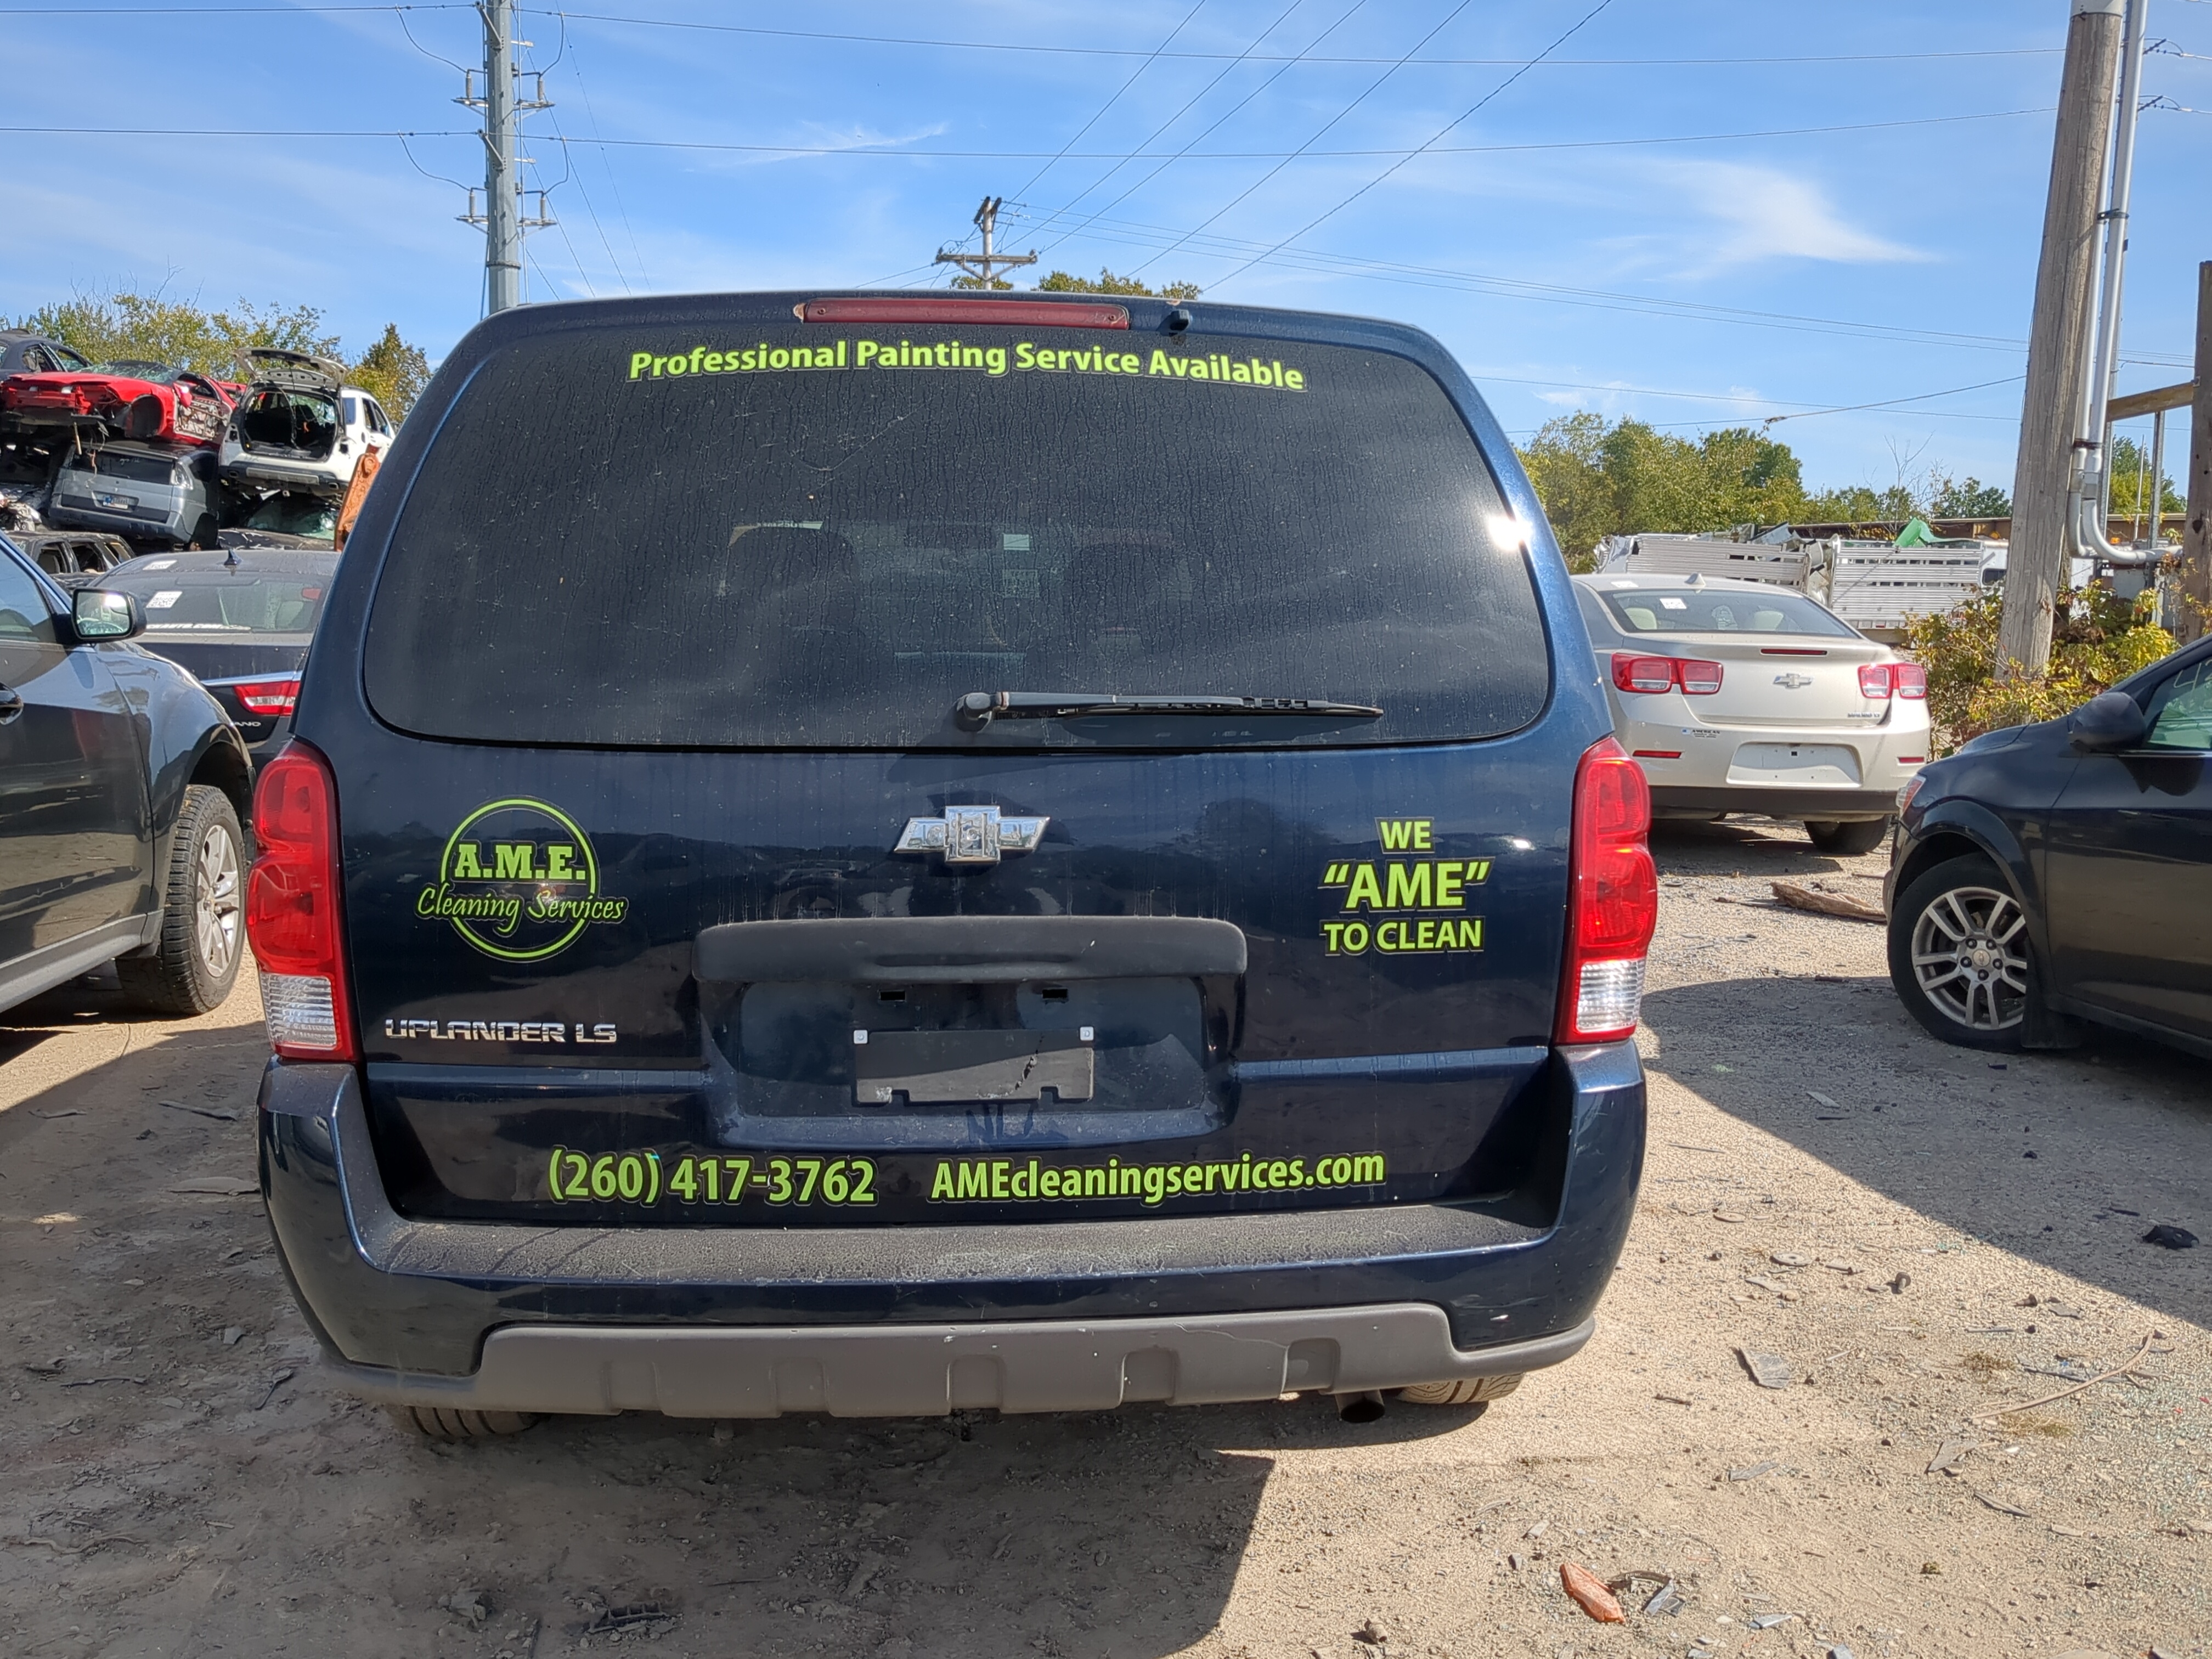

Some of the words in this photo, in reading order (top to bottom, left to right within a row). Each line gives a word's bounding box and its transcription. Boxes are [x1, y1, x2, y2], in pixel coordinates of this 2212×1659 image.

[629, 339, 847, 379] Professional
[856, 339, 1007, 375] Painting
[1015, 341, 1140, 374] Service
[1149, 349, 1304, 390] Available
[1380, 821, 1431, 849] WE
[454, 844, 586, 880] A.M.E.
[417, 882, 520, 933] Cleaning
[528, 890, 624, 919] Services
[1323, 922, 1369, 951] TO
[1376, 919, 1481, 950] CLEAN
[385, 1019, 566, 1042] UPLANDER
[576, 1023, 617, 1043] LS
[549, 1149, 659, 1203] (260)
[670, 1159, 874, 1203] 417-3762
[931, 1153, 1385, 1203] AMEcleaningservices.com
